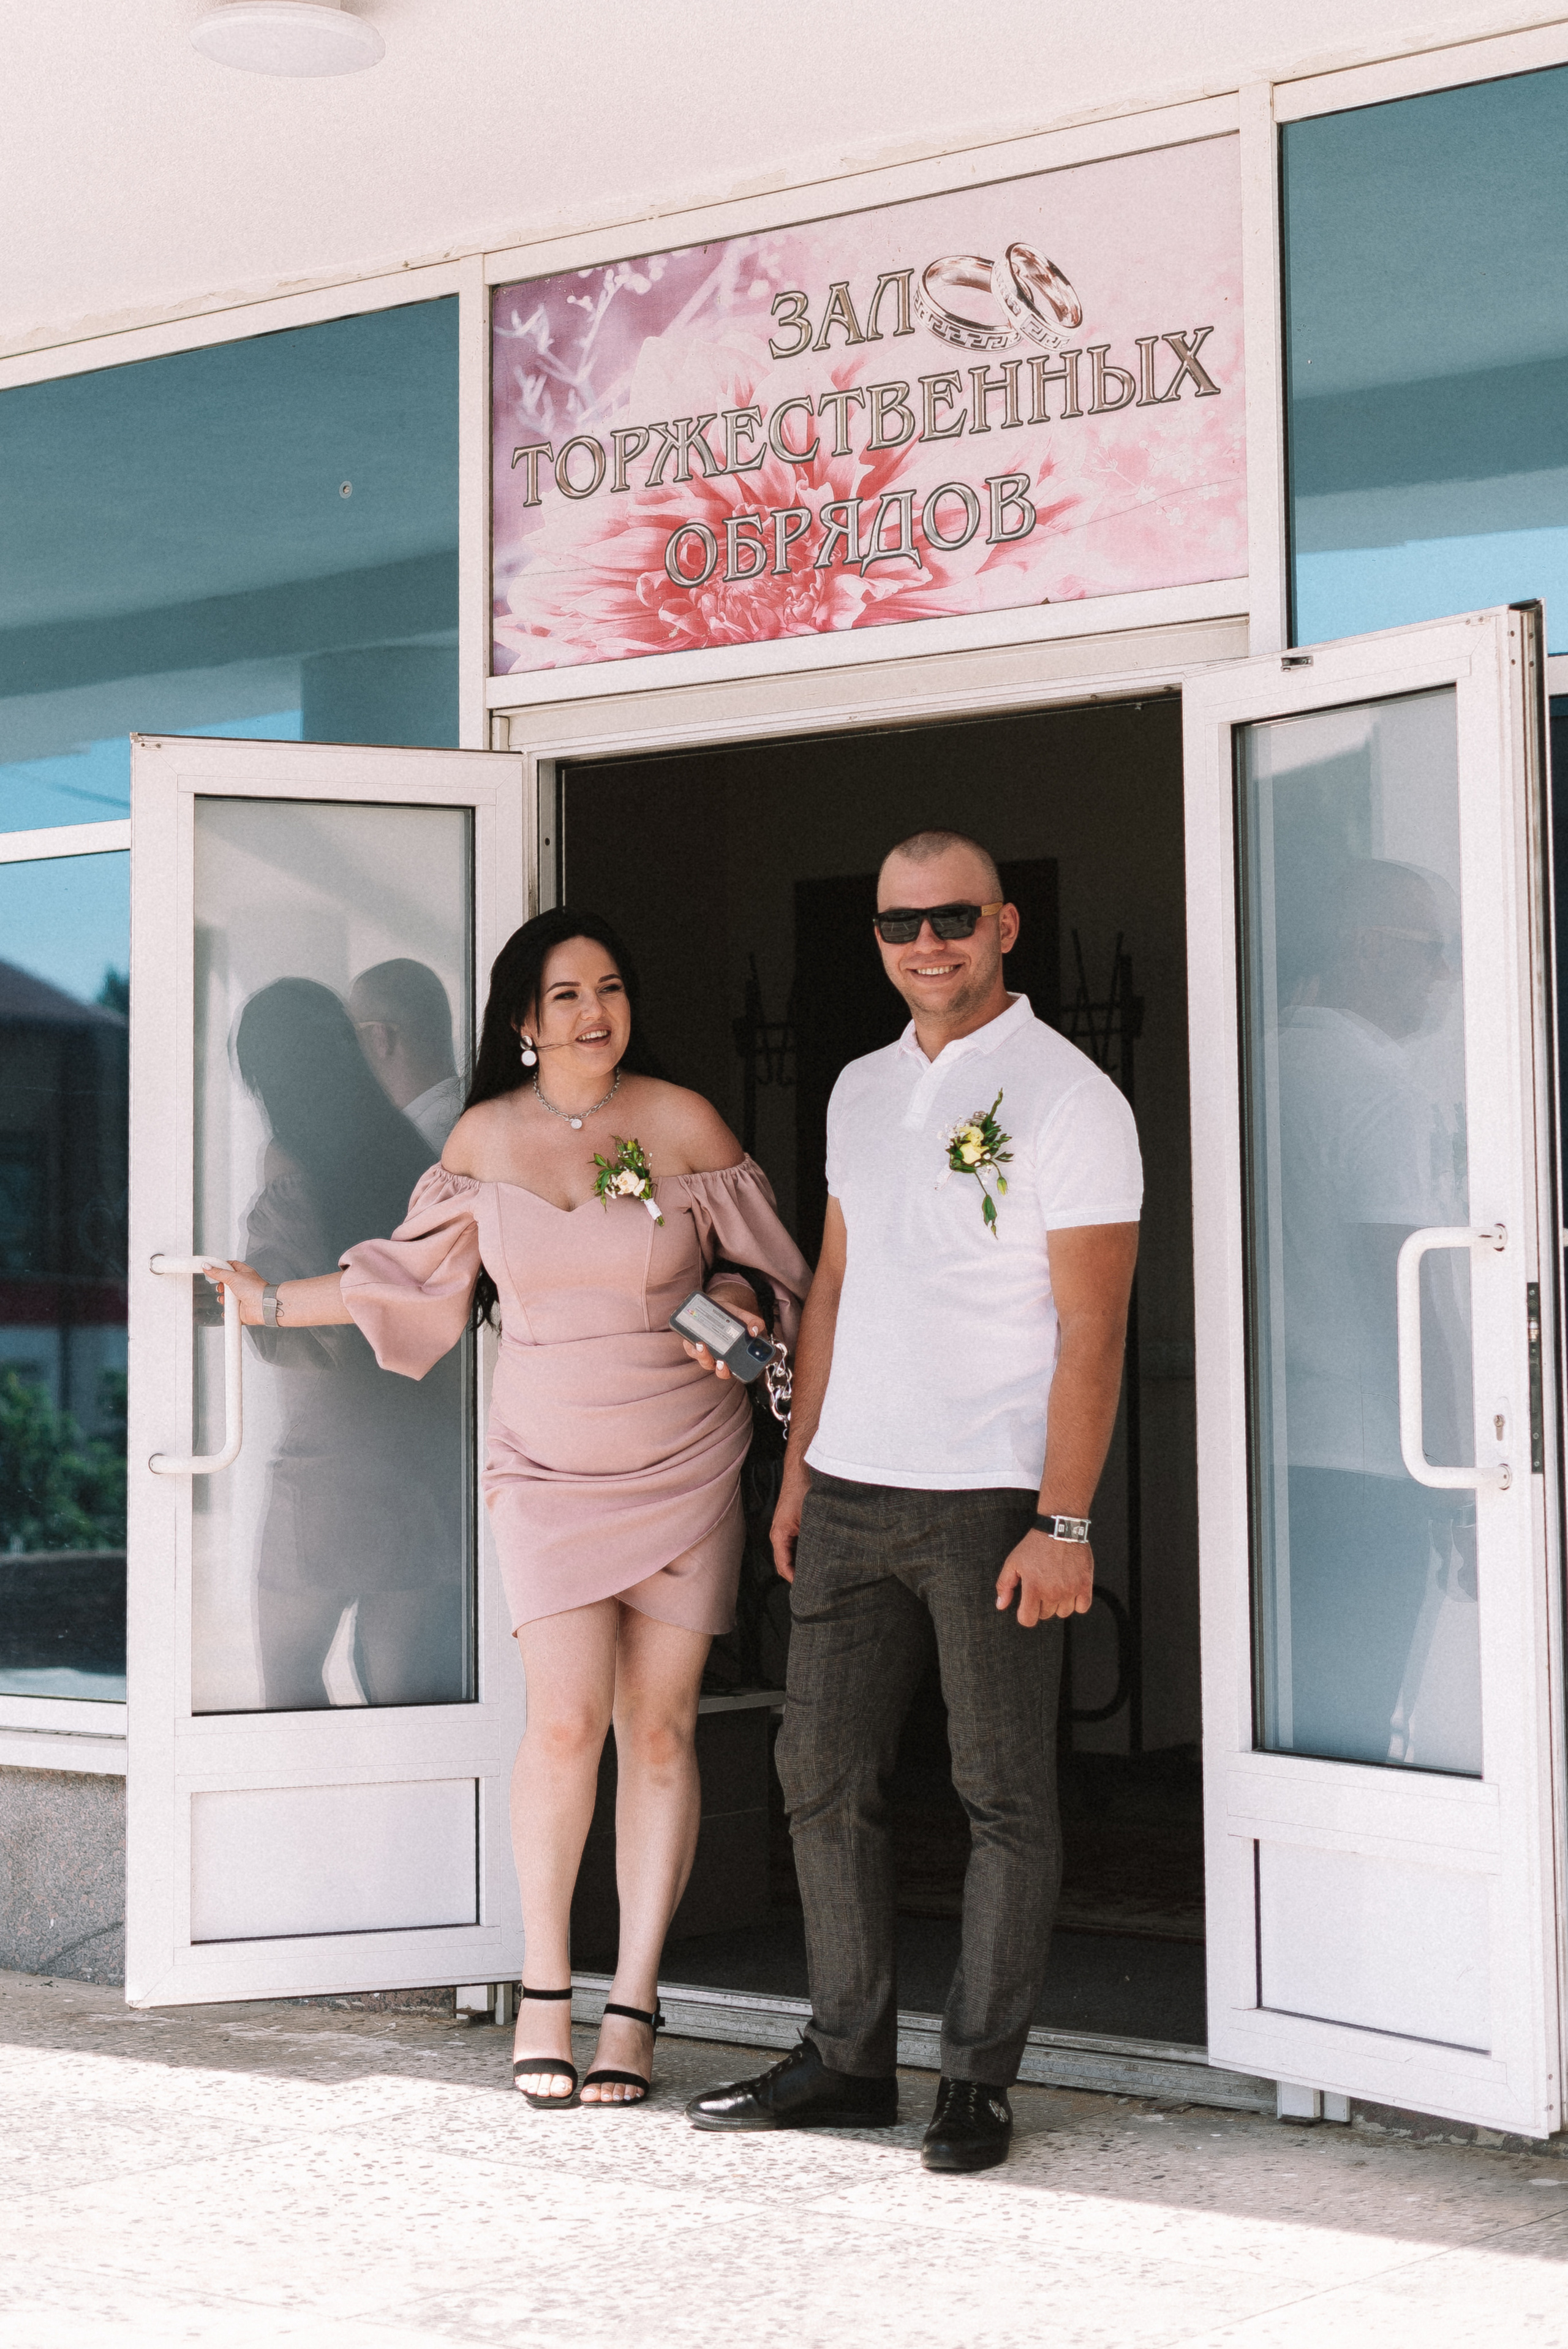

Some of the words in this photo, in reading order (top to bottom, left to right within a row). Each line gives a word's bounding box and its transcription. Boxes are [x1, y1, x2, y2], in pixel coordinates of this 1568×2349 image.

[769, 268, 915, 359] ЗАЛ
[511, 326, 1221, 508] ТОРЖЕСТВЕННЫХ
[665, 473, 1036, 589] ОБРЯДОВ
